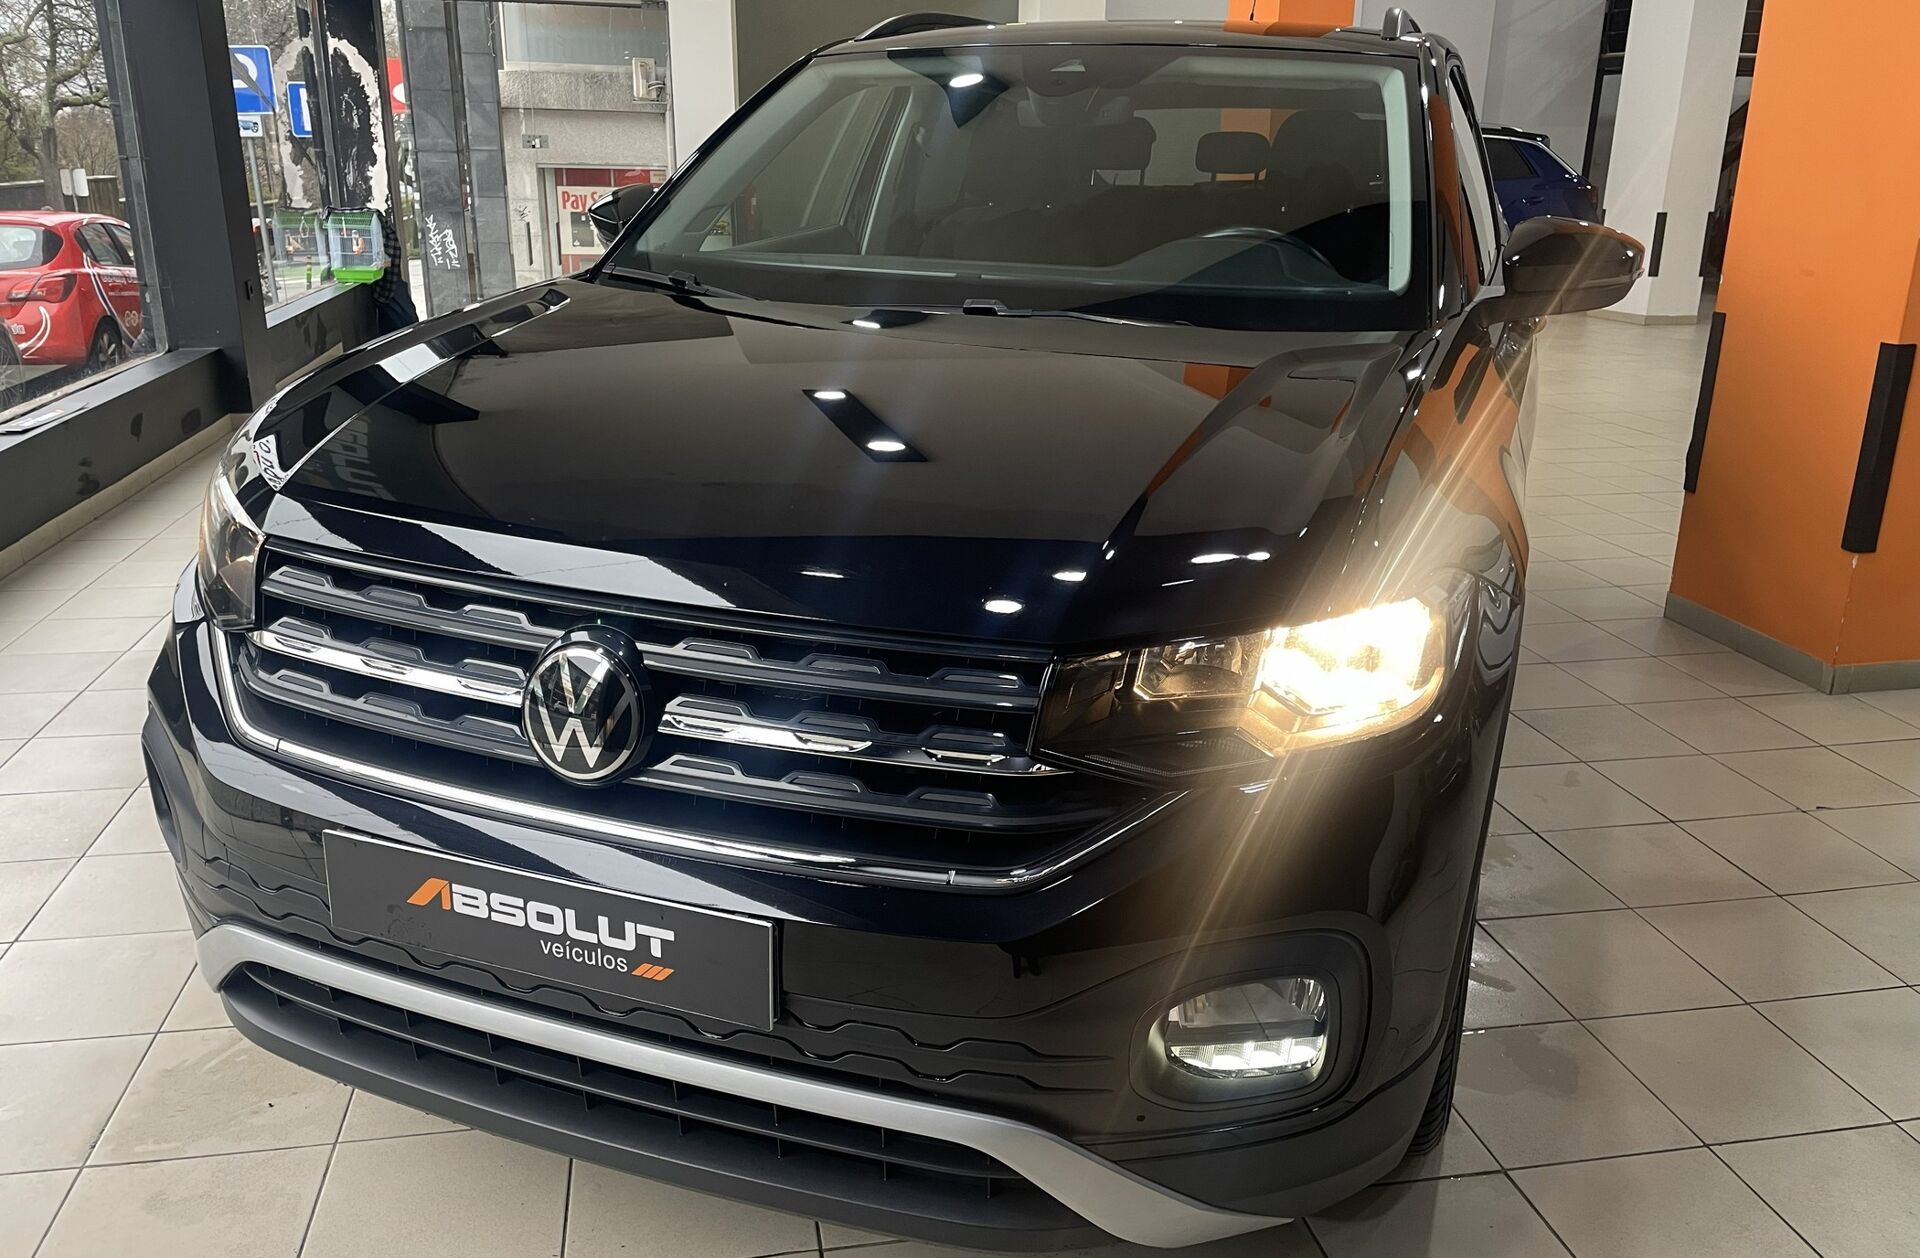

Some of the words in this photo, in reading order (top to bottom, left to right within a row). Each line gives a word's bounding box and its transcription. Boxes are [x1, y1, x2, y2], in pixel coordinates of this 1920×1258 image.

[562, 191, 588, 213] Pay
[406, 877, 675, 958] ABSOLUT
[540, 939, 629, 973] veículos
